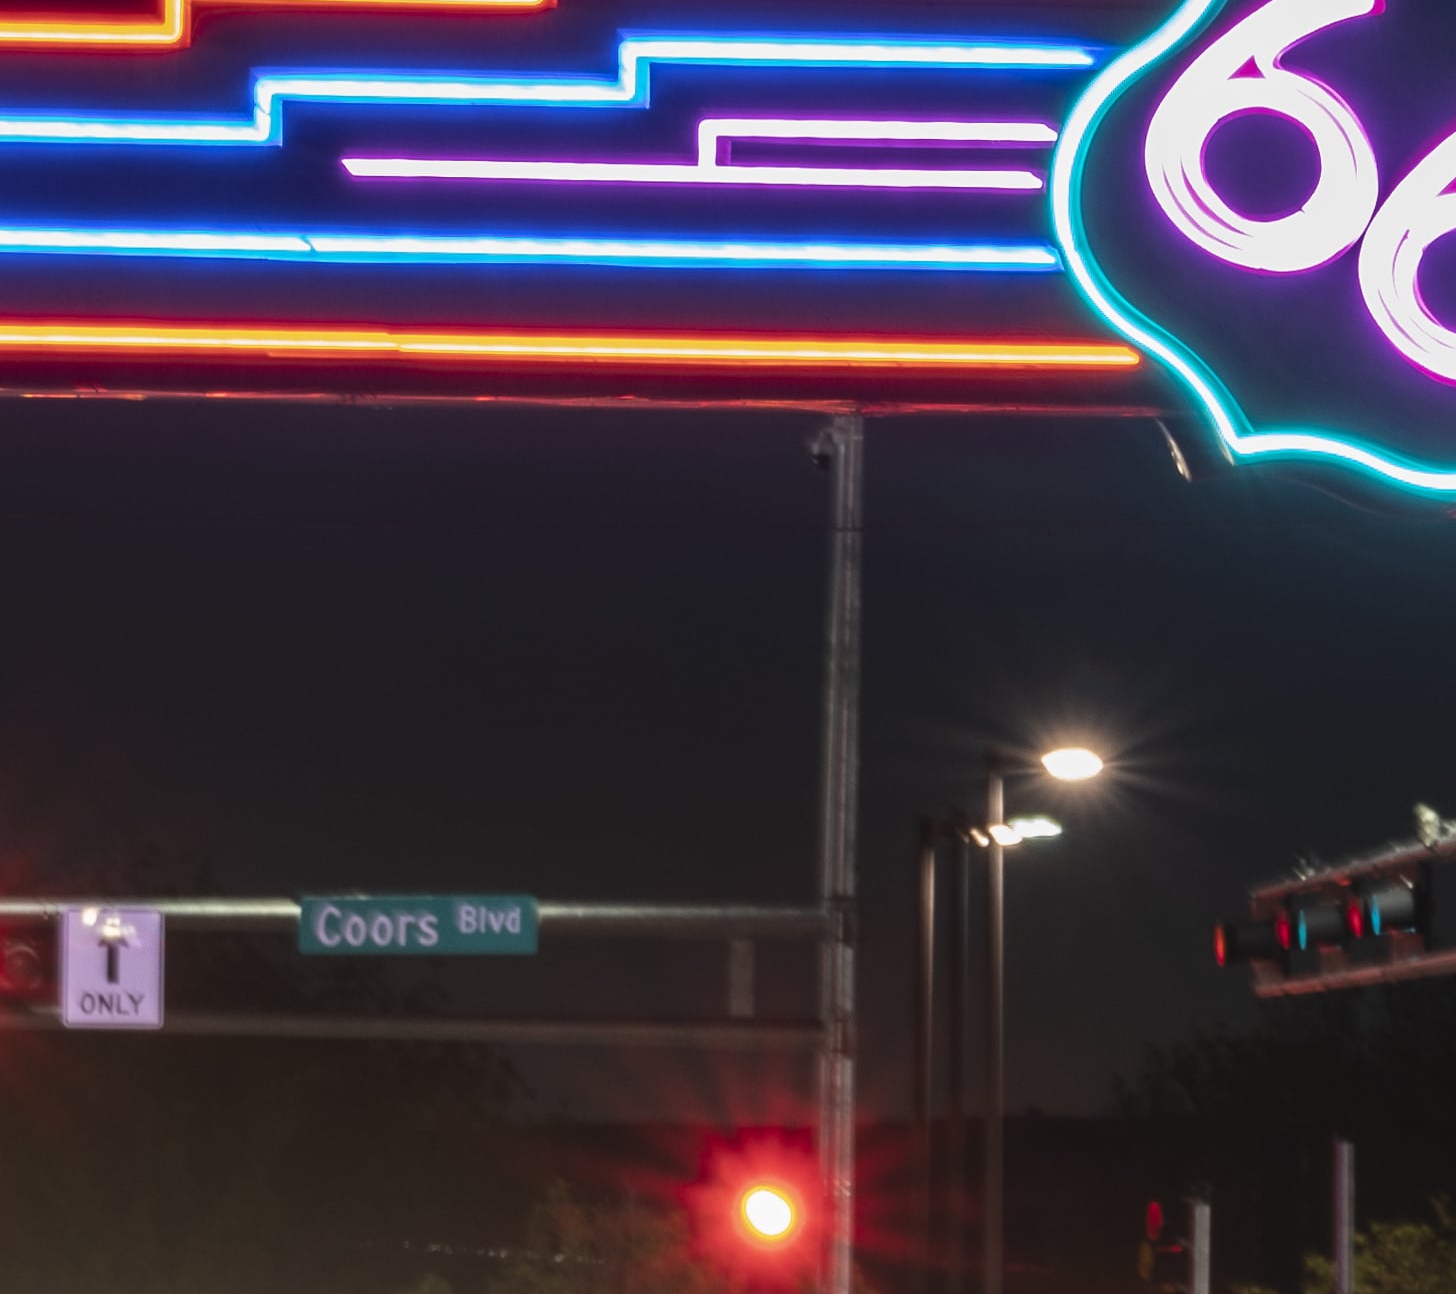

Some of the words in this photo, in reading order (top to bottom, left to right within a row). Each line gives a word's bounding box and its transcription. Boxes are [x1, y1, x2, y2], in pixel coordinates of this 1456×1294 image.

[315, 903, 440, 947] Coors
[456, 902, 522, 934] Blvd
[80, 992, 145, 1016] ONLY
